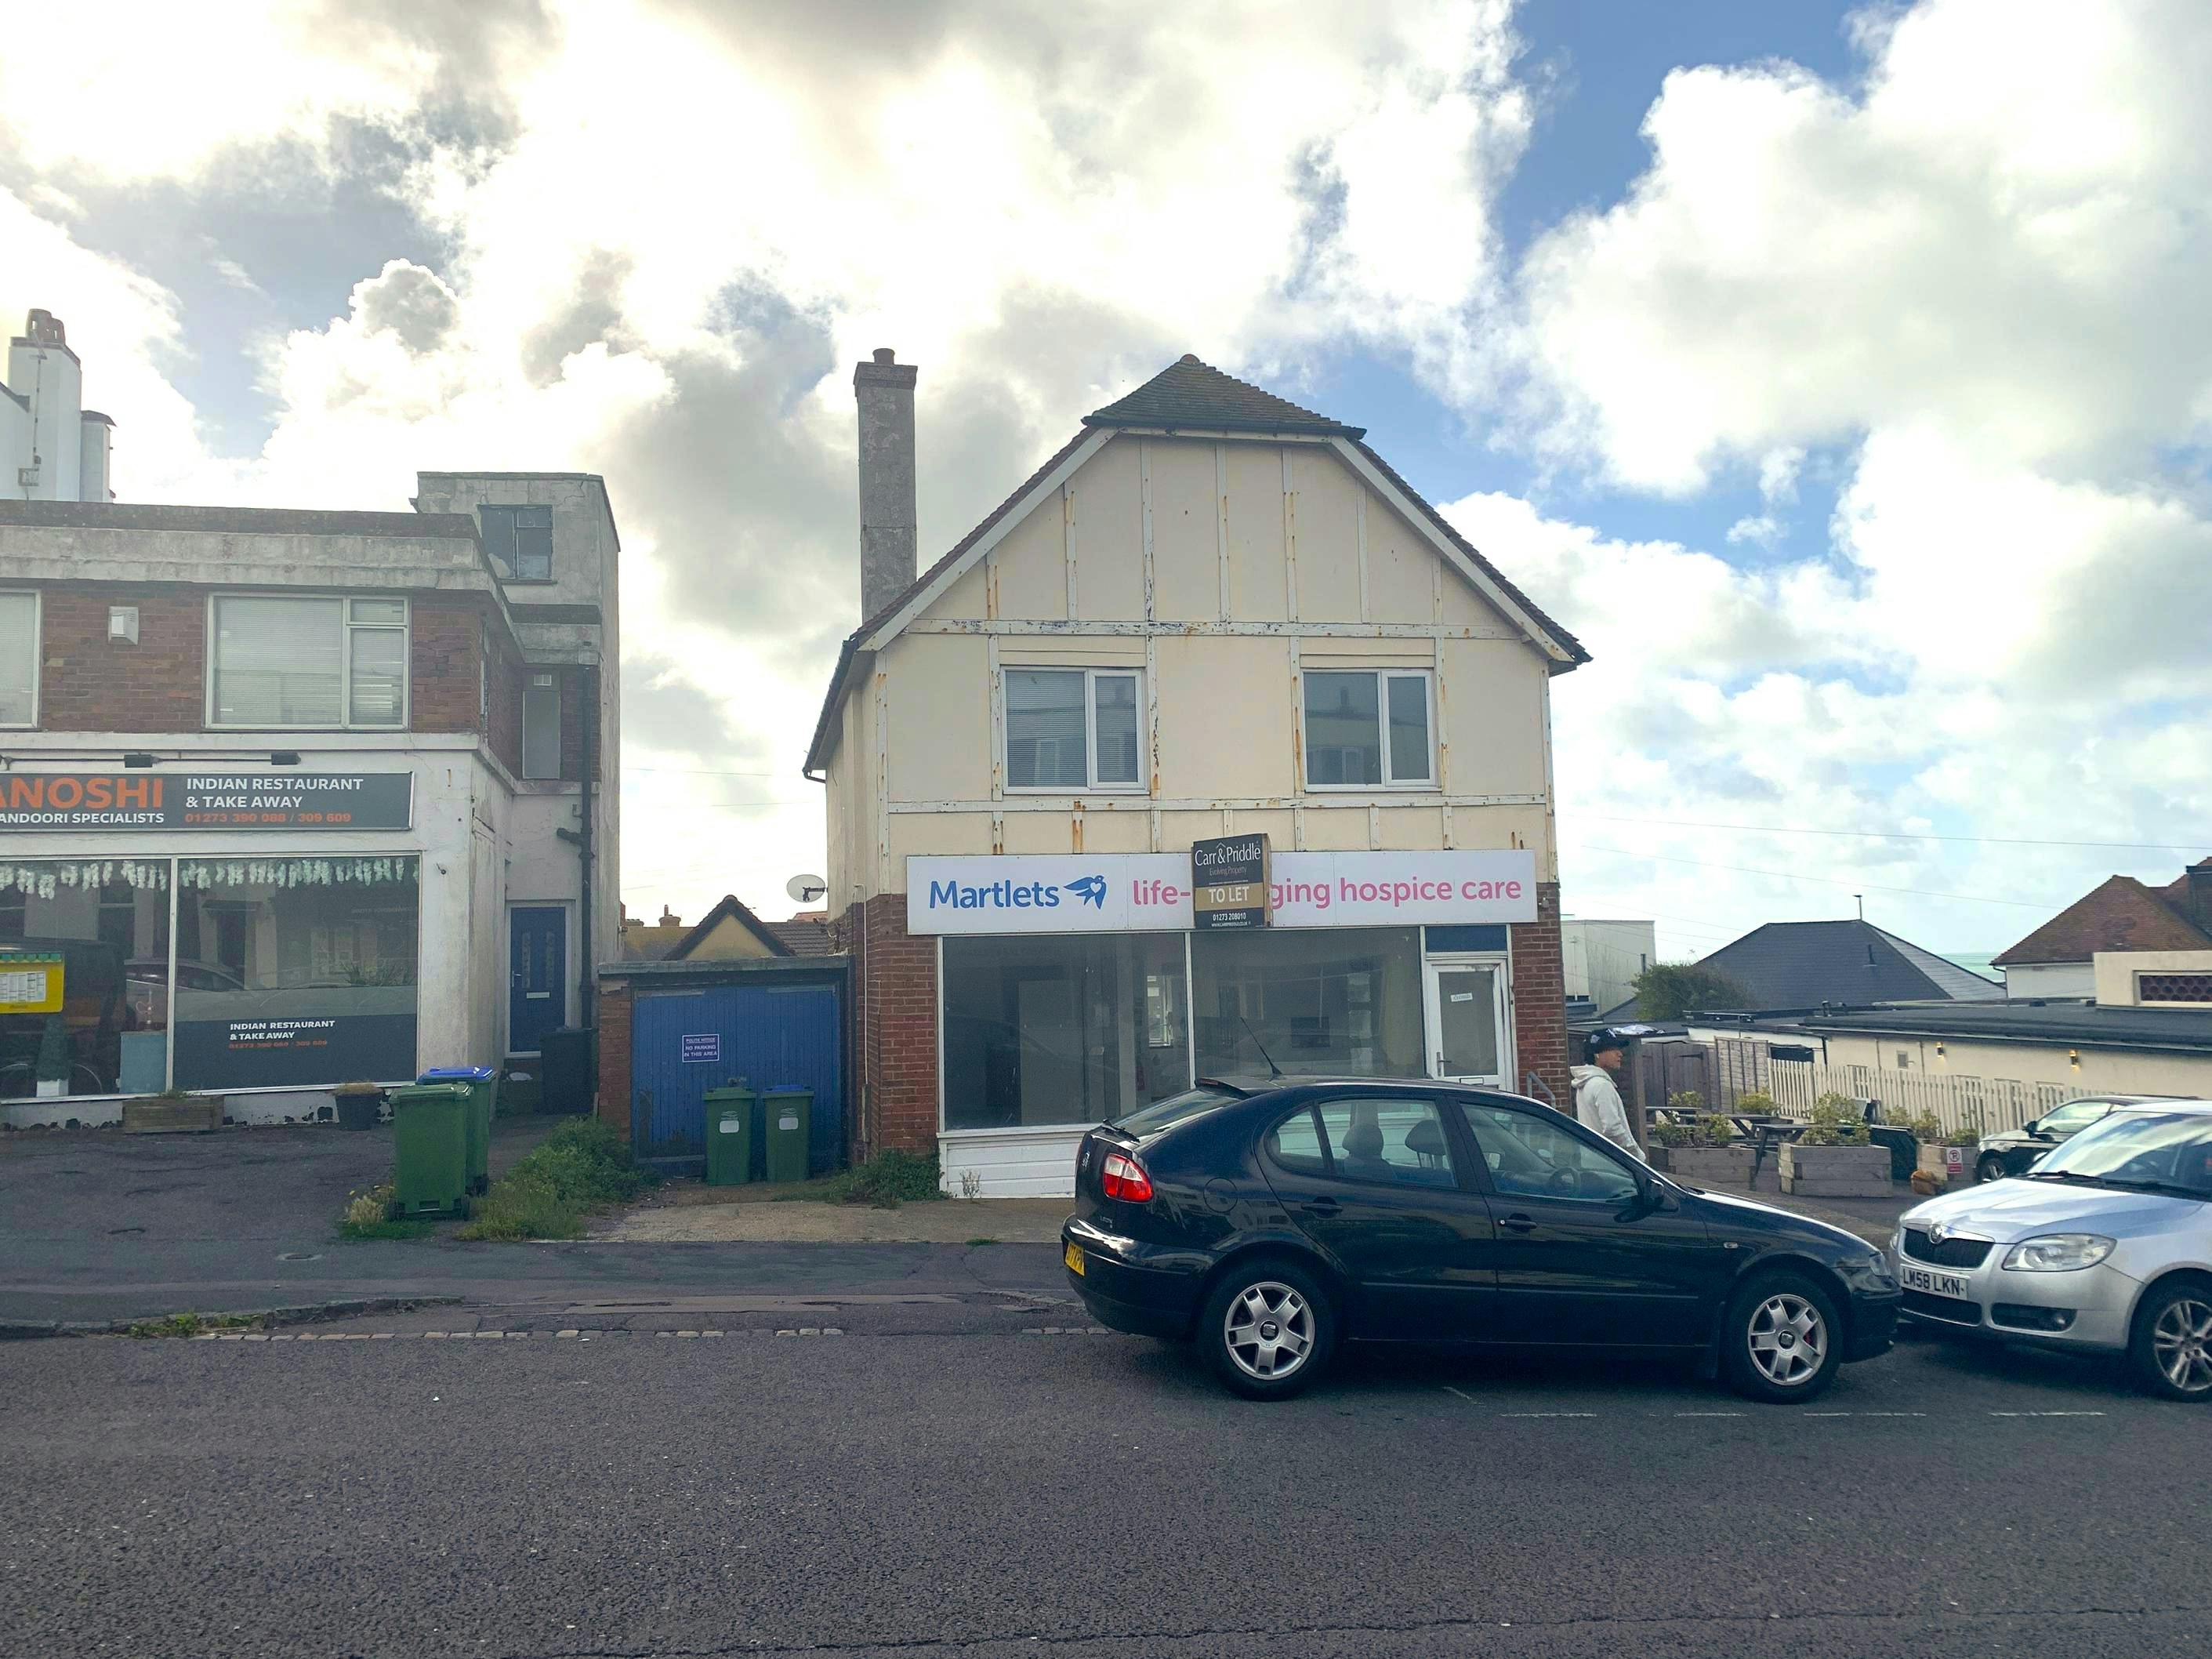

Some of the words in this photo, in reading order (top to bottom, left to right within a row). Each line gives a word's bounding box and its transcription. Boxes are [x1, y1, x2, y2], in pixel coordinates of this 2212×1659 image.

[187, 778, 248, 790] INDIAN
[252, 778, 364, 790] RESTAURANT
[185, 796, 198, 808] &
[202, 796, 248, 808] TAKE
[250, 796, 303, 808] AWAY
[71, 812, 165, 823] SPECIALISTS
[184, 812, 227, 822] 01273
[298, 812, 323, 822] 309
[326, 812, 352, 822] 609
[1195, 849, 1217, 866] Carr
[1217, 848, 1225, 864] &
[1227, 843, 1260, 862] Priddle
[929, 880, 1060, 909] Martlets
[1208, 888, 1225, 903] TO
[1228, 886, 1249, 902] LET
[1340, 877, 1452, 907] hospice
[1461, 880, 1521, 900] care
[270, 1020, 335, 1029] RESTAURANT
[1903, 1269, 1930, 1289] LM58
[1934, 1276, 1960, 1295] LKN
